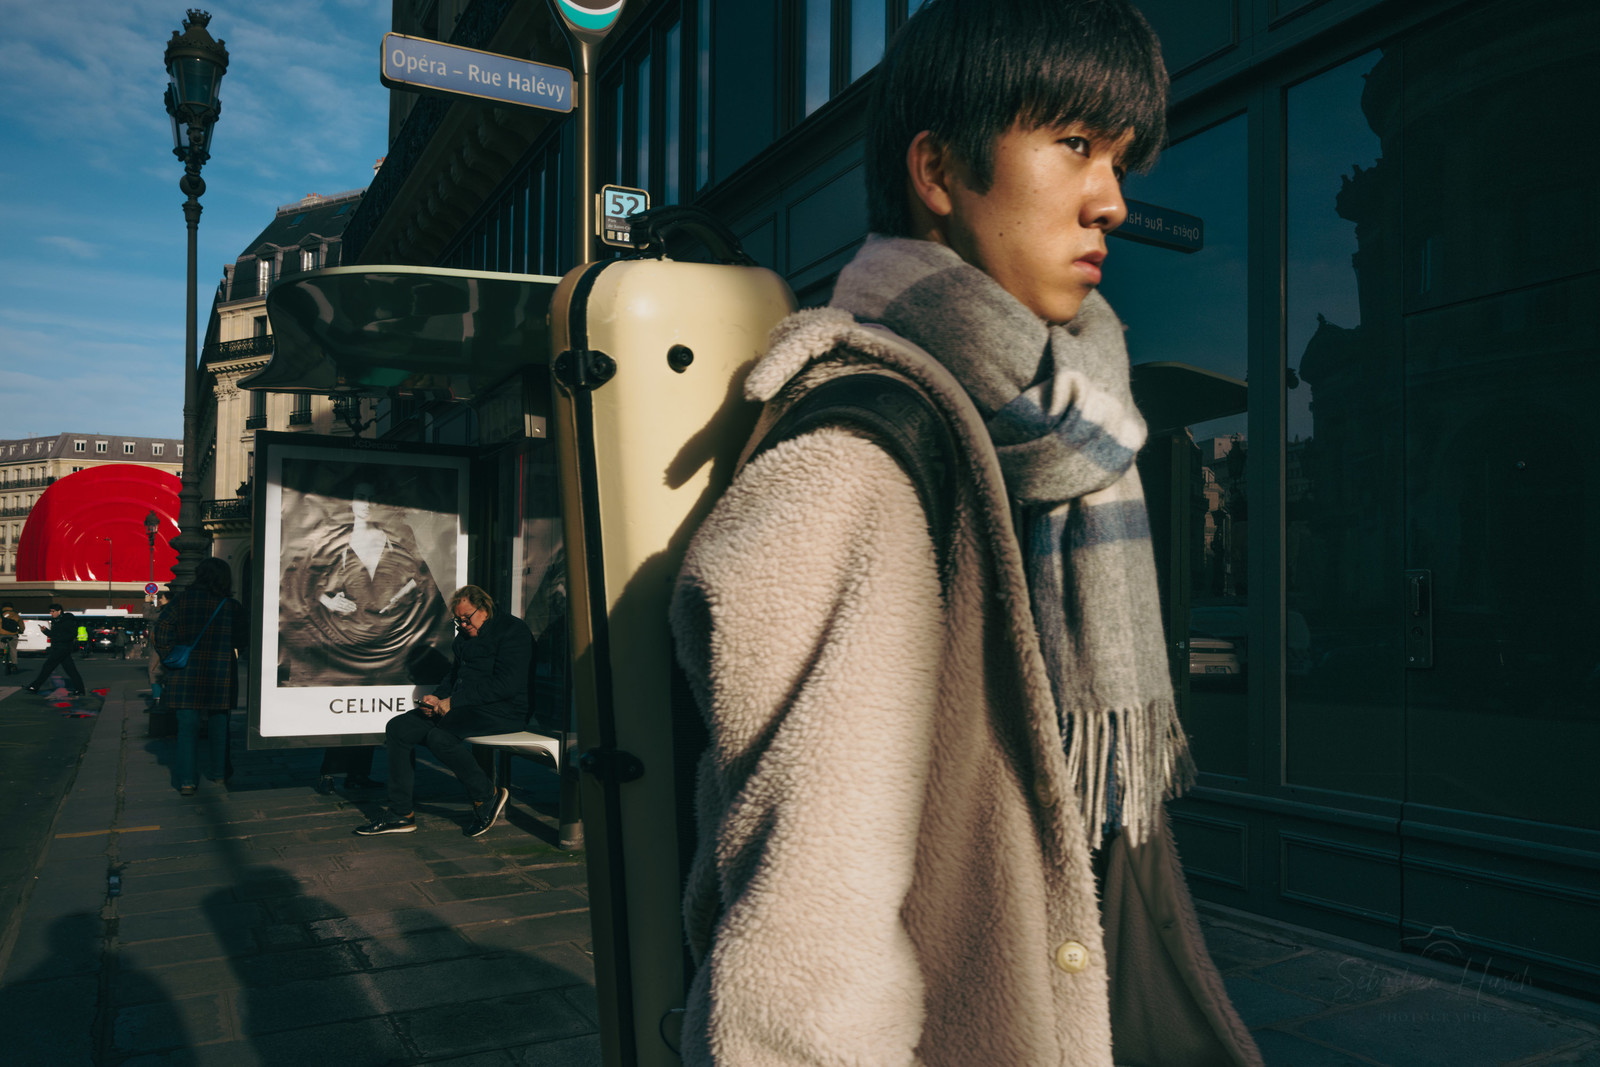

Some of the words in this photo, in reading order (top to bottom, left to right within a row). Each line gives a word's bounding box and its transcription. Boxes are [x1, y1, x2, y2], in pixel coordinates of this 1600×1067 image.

[392, 49, 447, 76] Opéra
[468, 64, 501, 87] Rue
[508, 72, 565, 102] Halévy
[611, 194, 639, 216] 52
[329, 697, 406, 714] CELINE
